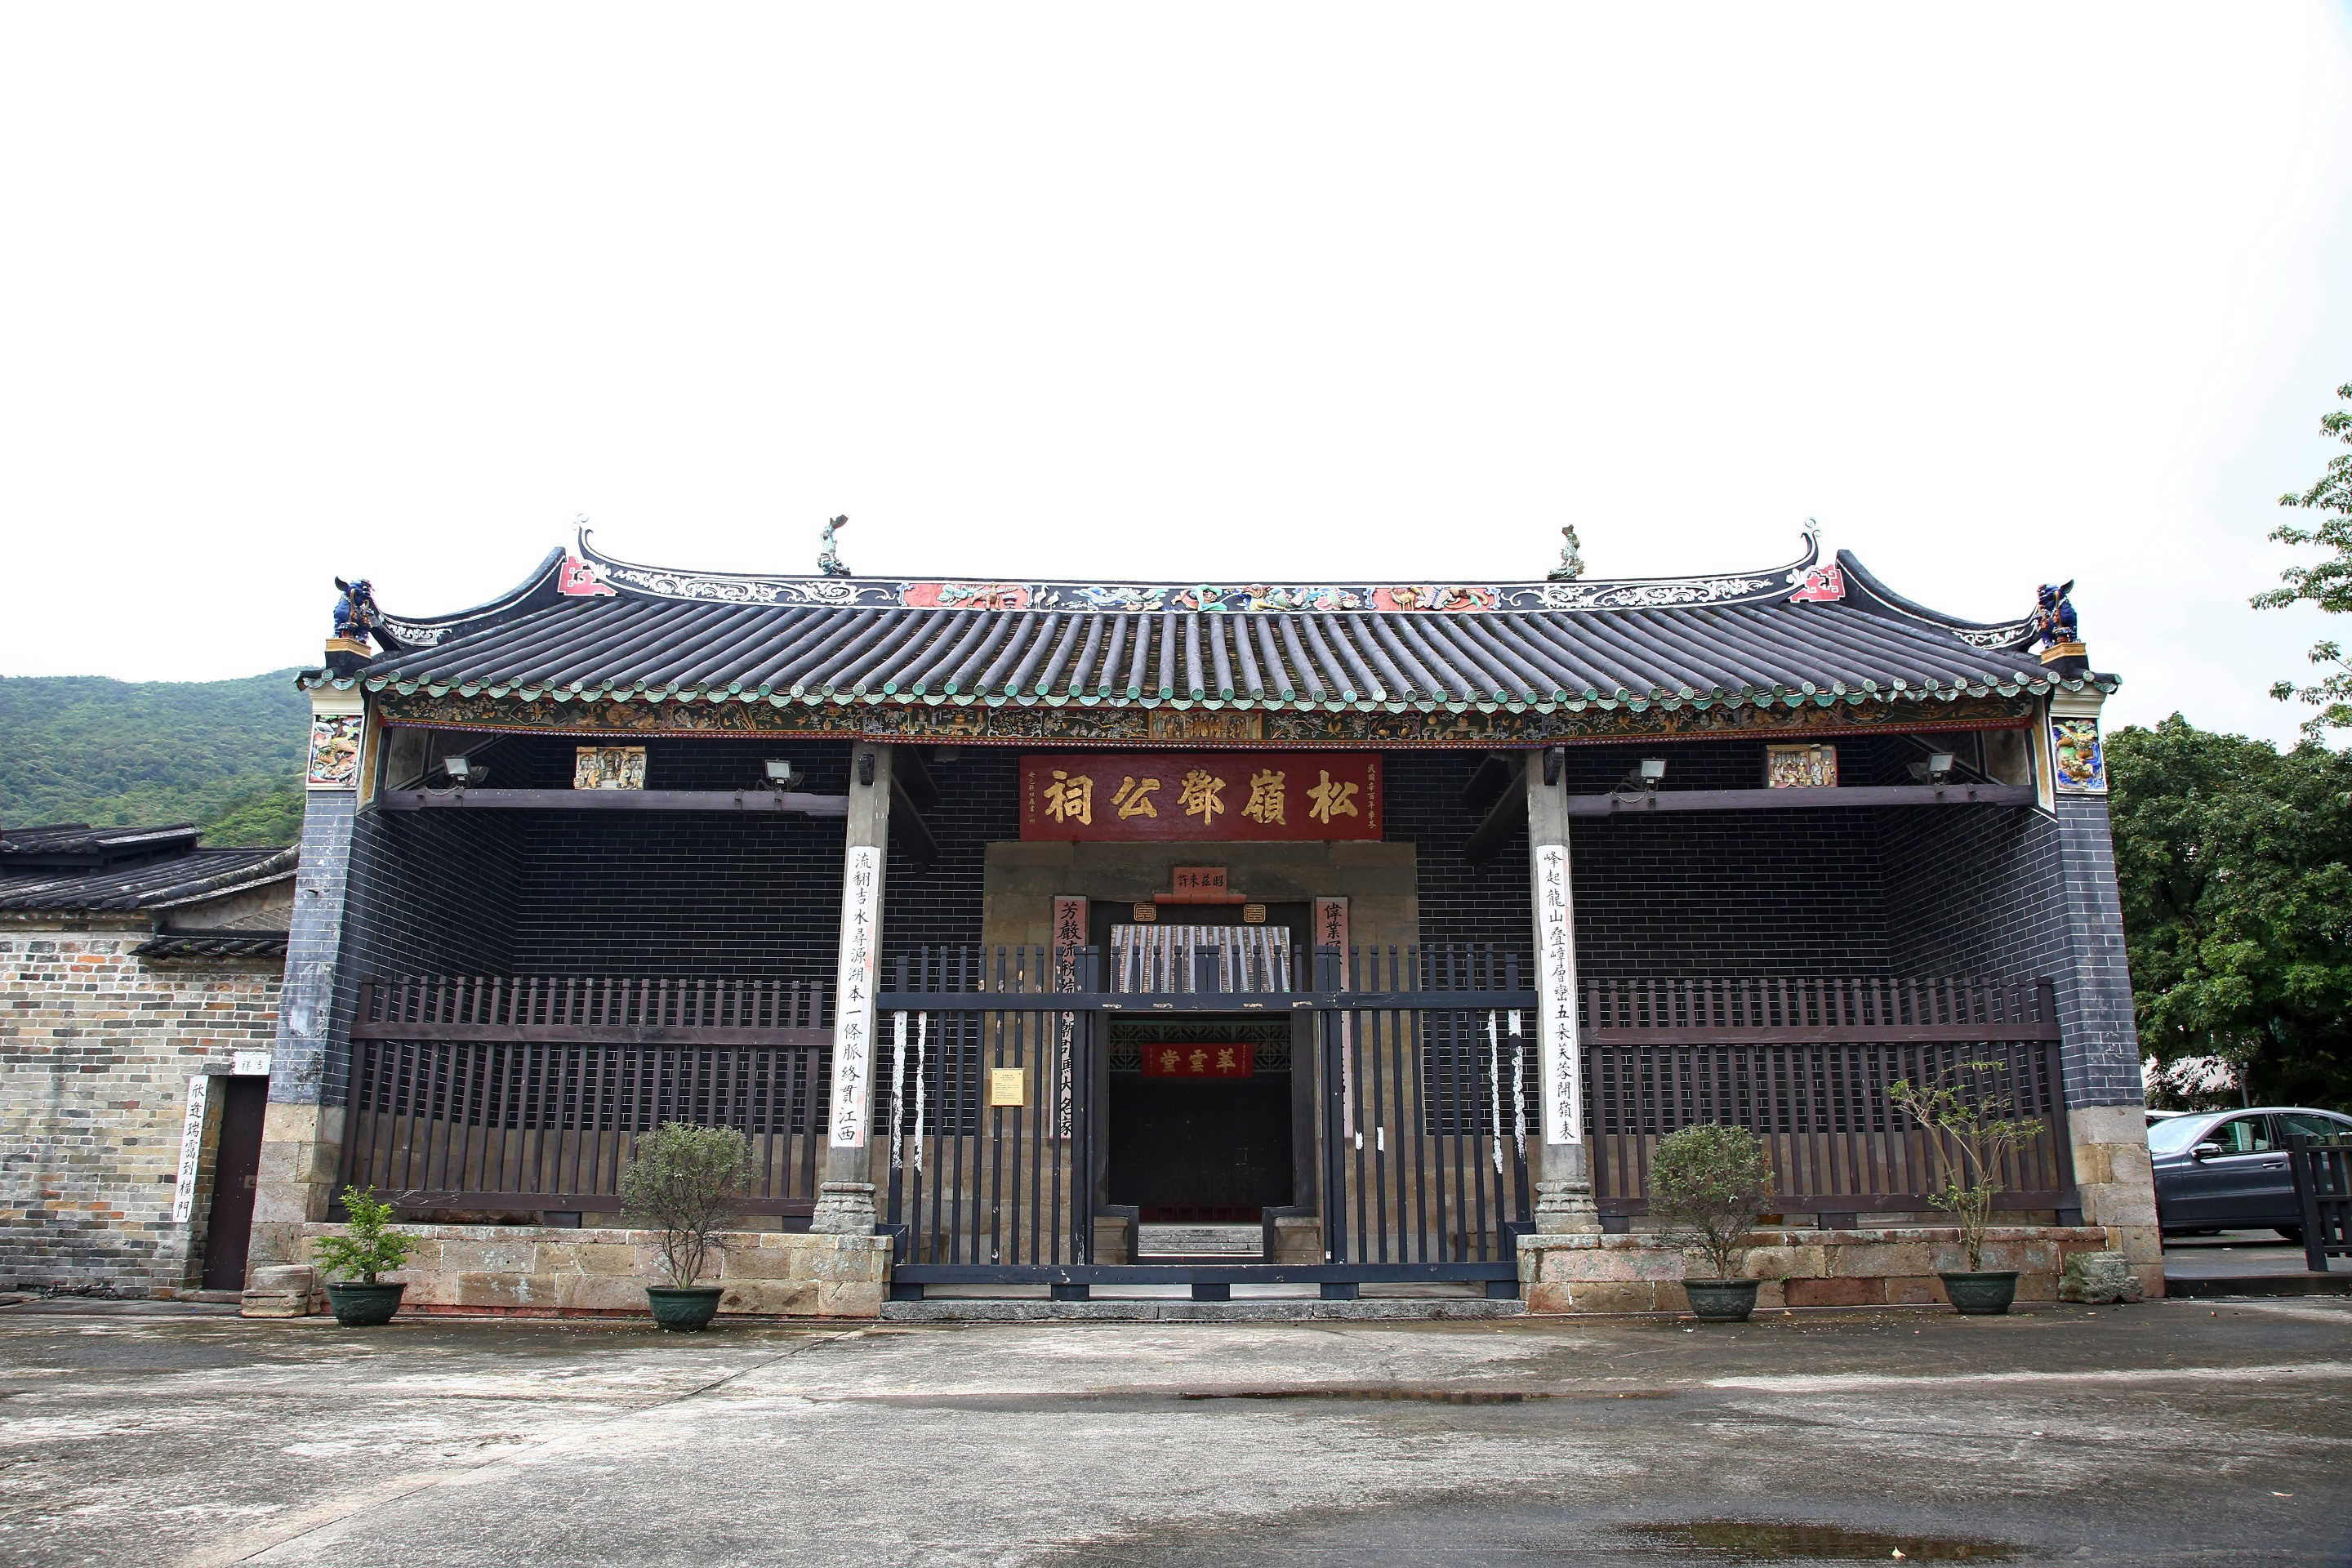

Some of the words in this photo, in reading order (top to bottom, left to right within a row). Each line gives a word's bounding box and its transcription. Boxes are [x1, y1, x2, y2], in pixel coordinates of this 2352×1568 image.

[1044, 768, 1360, 826] 松嶺鄧公祠
[241, 1059, 264, 1071] 吉祥
